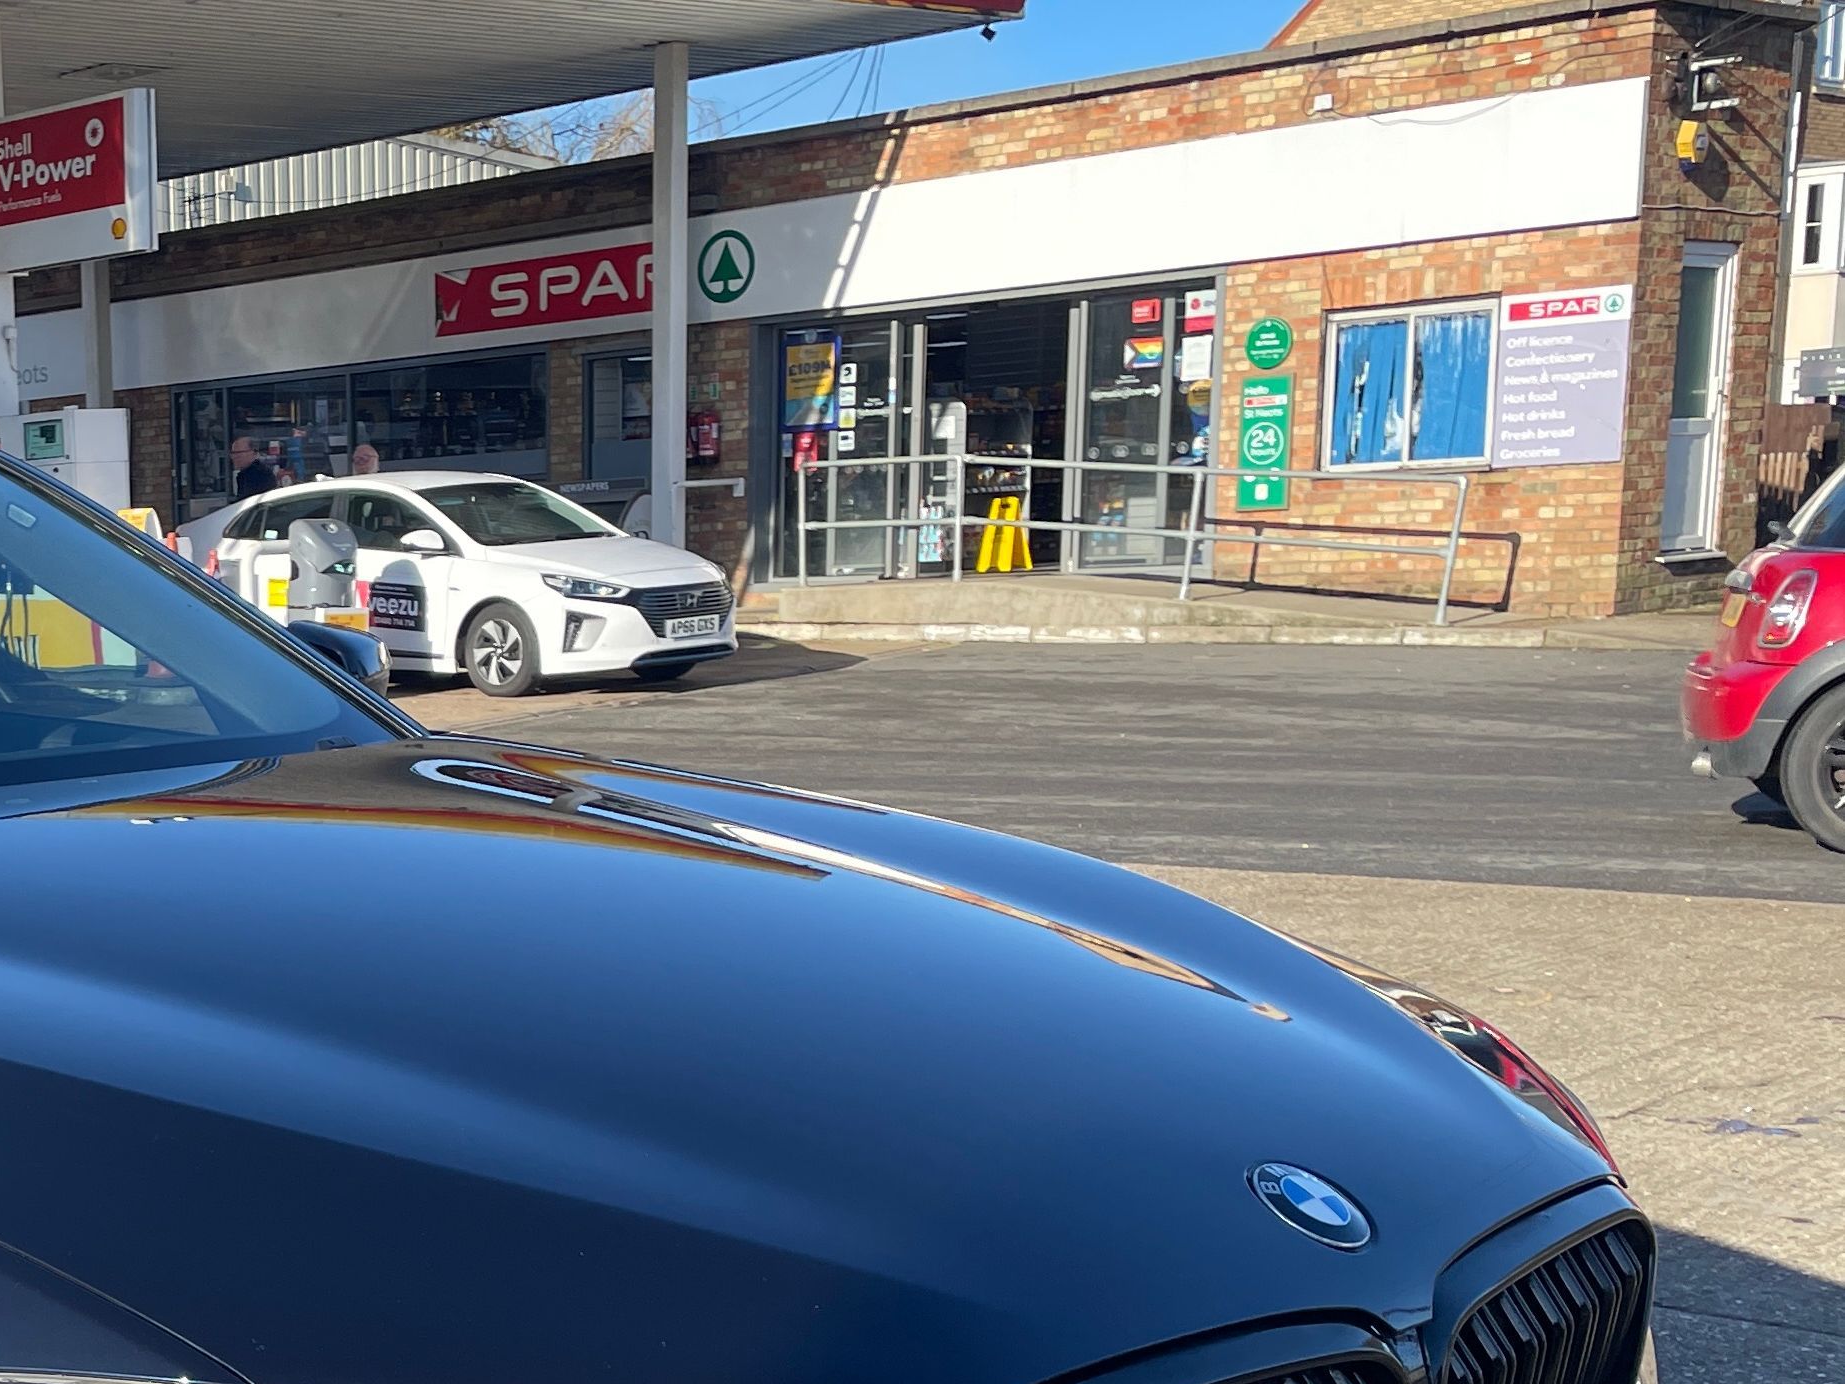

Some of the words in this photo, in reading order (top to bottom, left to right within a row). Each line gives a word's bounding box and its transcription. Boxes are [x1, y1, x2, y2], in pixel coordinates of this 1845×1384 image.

[43, 189, 62, 204] Fuels
[1528, 298, 1599, 318] SPAR
[1506, 336, 1528, 349] Off
[1529, 335, 1573, 347] licence
[1504, 374, 1537, 386] News
[1550, 369, 1618, 384] magazines
[1503, 394, 1525, 404] Hot
[1527, 389, 1557, 401] food
[1501, 411, 1525, 422] Hot
[1526, 409, 1566, 421] drinks
[1250, 427, 1276, 448] 24
[1500, 429, 1535, 441] Fresh
[1536, 426, 1575, 439] bread
[1499, 446, 1561, 459] Groceries
[559, 481, 609, 493] NEWSPAPERS
